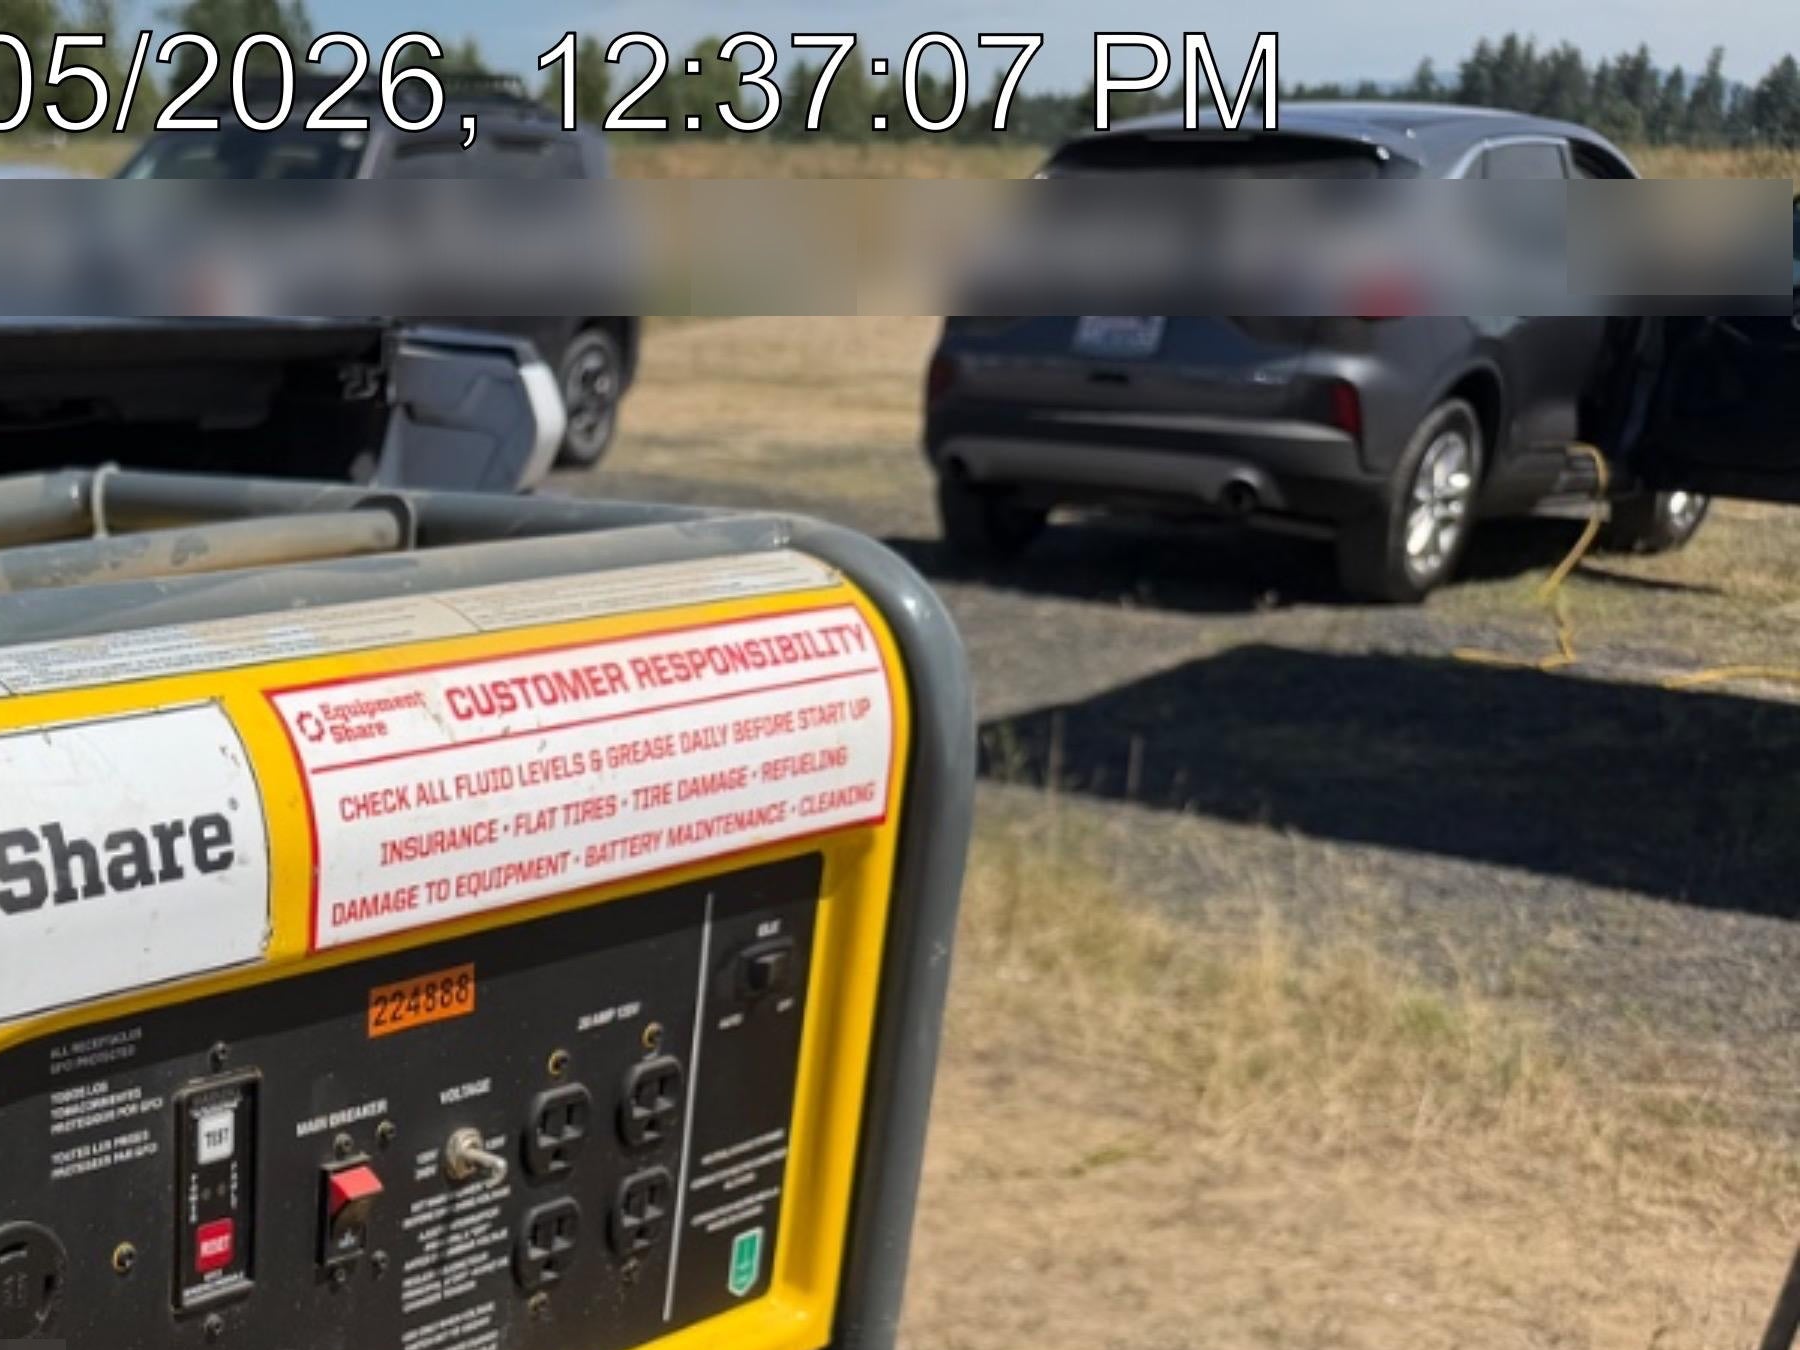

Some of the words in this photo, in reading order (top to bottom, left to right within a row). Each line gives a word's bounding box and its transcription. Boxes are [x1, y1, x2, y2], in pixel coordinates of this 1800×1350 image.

[445, 661, 630, 721] CUSTOMER
[627, 622, 868, 690] RESPONSIBILITY
[319, 690, 426, 722] Equipment
[329, 717, 389, 744] Share
[338, 785, 412, 823] CHECK
[415, 777, 453, 808] ALL
[454, 765, 515, 800] FLUID
[517, 752, 587, 787] LEVELS
[605, 734, 675, 770] GREASE
[680, 723, 730, 755] DAILY
[731, 709, 796, 744] BEFORE
[798, 700, 847, 731] START
[848, 697, 872, 721] UP
[379, 818, 500, 868] INSURANCE
[512, 805, 559, 838] FLAT
[562, 794, 618, 826] TIRES
[632, 781, 674, 812] TIRE
[677, 764, 750, 800] DAMAGE
[761, 745, 849, 784] REFUELING
[331, 884, 421, 928] DAMAGE
[425, 878, 452, 906] TO
[454, 851, 571, 899] EQUIPMENT
[584, 827, 664, 869] BATTERY
[665, 799, 788, 848] MAINTENANCE
[799, 780, 877, 818] CLEANING
[373, 972, 470, 1027] 224888
[296, 1115, 329, 1138] MAIN
[329, 1097, 389, 1129] BREAKER
[439, 1077, 492, 1105] VOLTAGE
